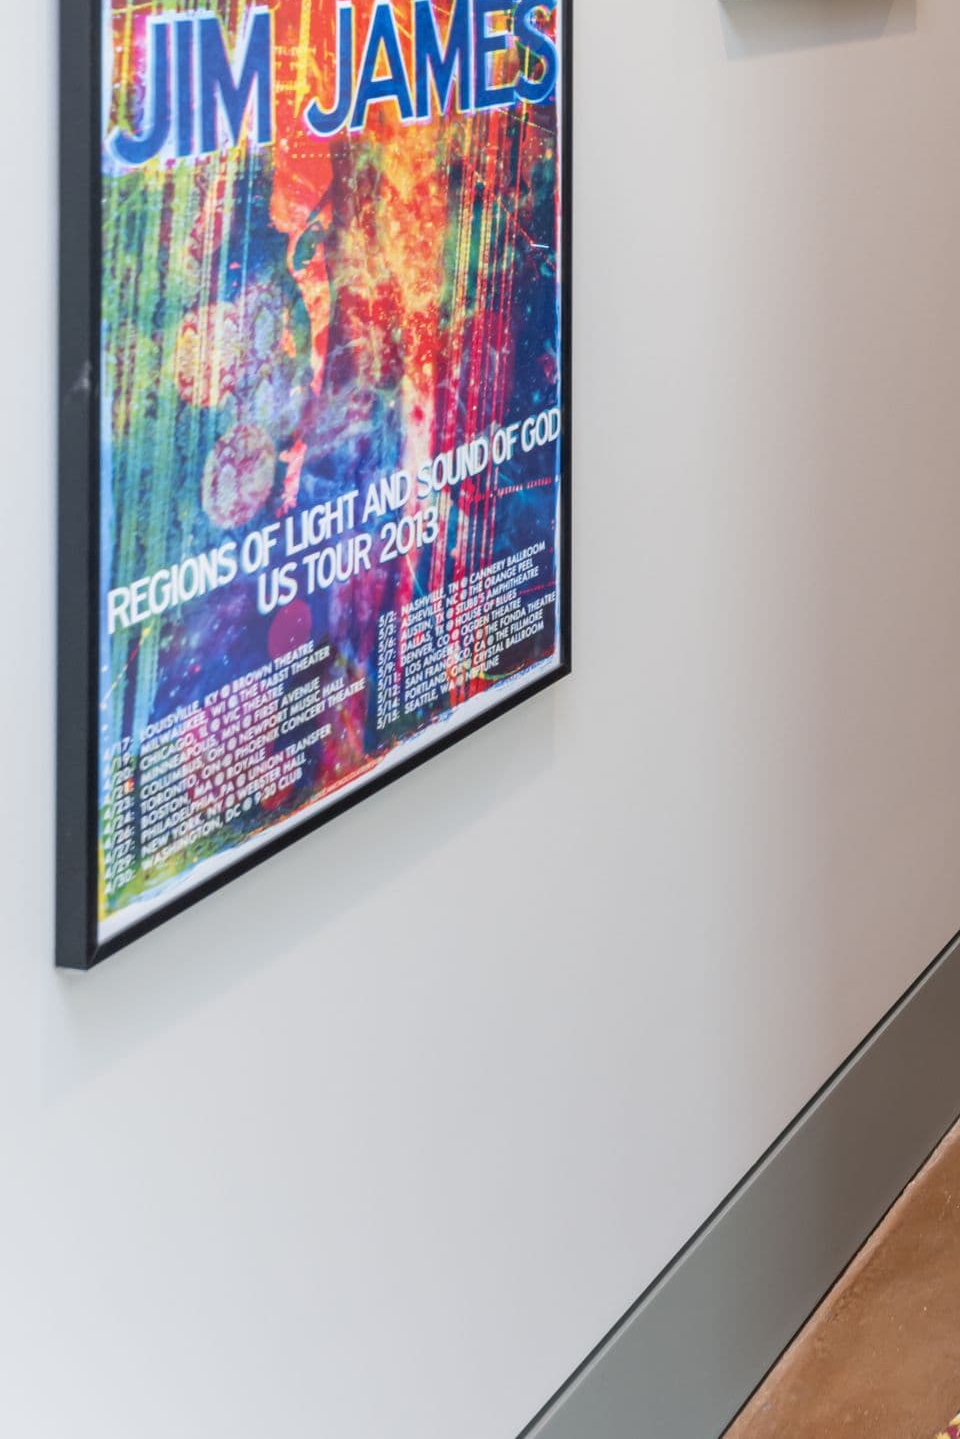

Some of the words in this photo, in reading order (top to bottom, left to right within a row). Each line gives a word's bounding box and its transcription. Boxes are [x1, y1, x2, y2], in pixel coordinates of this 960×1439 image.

[105, 5, 275, 166] JIM
[106, 543, 236, 634] REGIONS
[241, 523, 287, 574] OF
[285, 492, 367, 556] LIGHT
[362, 476, 412, 523] AND
[416, 442, 490, 499] SOUND
[491, 420, 522, 462] OF
[520, 408, 561, 452] GOD
[256, 566, 299, 615] US
[302, 534, 372, 601] TOUR
[380, 506, 439, 563] 2013
[378, 610, 396, 627] 5/2:
[401, 587, 446, 615] NASHVILLE,
[448, 582, 458, 593] TN
[469, 560, 505, 582] CANNERY
[507, 542, 545, 565] BALLROOM
[378, 623, 396, 639] 5/3:
[400, 600, 444, 627] ASHEVILLE,
[445, 593, 458, 605] NC
[469, 582, 482, 594] THE
[483, 566, 516, 587] ORANGE
[518, 558, 533, 571] PEEL
[378, 636, 396, 652] 5/6:
[400, 618, 432, 639] AUSTIN,
[455, 593, 484, 613] STUBB'S
[486, 567, 538, 598] AMPHITHEATRE
[378, 648, 396, 665] 5/7:
[400, 630, 432, 652] DALLAS,
[455, 606, 481, 625] HOUSE
[483, 600, 495, 611] OF
[495, 589, 516, 605] BLUES
[204, 690, 218, 706] KY
[232, 662, 272, 692] BROWN
[273, 640, 313, 670] THEATRE
[376, 696, 400, 716] 5/14:
[404, 670, 448, 700] PORTLAND,
[473, 641, 504, 663] CRYSTAL
[505, 621, 544, 646] BALLROOM
[377, 671, 400, 691] 5/11:
[404, 661, 420, 675] LOS
[463, 633, 474, 645] CA
[484, 621, 498, 634] THE
[500, 607, 526, 626] FONDA
[527, 591, 556, 611] THEATRE
[377, 683, 400, 703] 5/12:
[404, 672, 423, 687] SAN
[474, 639, 485, 651] CA
[495, 627, 508, 640] THE
[510, 609, 543, 632] FILLMORE
[378, 661, 396, 677] 5/9:
[400, 642, 434, 664] DENVER,
[436, 633, 450, 646] CO
[460, 614, 489, 634] OGDEN
[491, 598, 521, 619] THEATRE
[206, 743, 225, 762] OH
[239, 708, 288, 743] NEWPORT
[289, 690, 320, 715] MUSIC
[322, 677, 344, 696] HALL
[211, 701, 225, 717] WI
[239, 684, 257, 702] THE
[259, 667, 288, 691] PABST
[291, 645, 329, 674] THEATER
[220, 720, 240, 740] MN
[254, 699, 278, 721] FIRST
[280, 676, 320, 707] AVENUE
[376, 708, 400, 729] 5/15:
[404, 688, 438, 713] SEATTLE,
[439, 679, 455, 693] WA
[139, 730, 197, 770] CHICAGO,
[222, 707, 240, 725] VIC
[242, 683, 283, 714] THEATRE
[140, 771, 199, 813] TORONTO,
[201, 759, 220, 778] ON
[234, 726, 279, 760] PHOENIX
[280, 700, 325, 733] CONCERT
[327, 678, 365, 706] THEATRE
[219, 779, 234, 796] PA
[247, 750, 283, 780] UNION
[285, 722, 331, 758] TRANSFER
[226, 747, 265, 778] ROYALE
[141, 831, 169, 856] NEW
[206, 800, 223, 818] NY
[237, 766, 280, 800] WEBSTER
[282, 751, 306, 773] HALL
[225, 803, 241, 820] DC
[277, 766, 302, 789] CLUB
